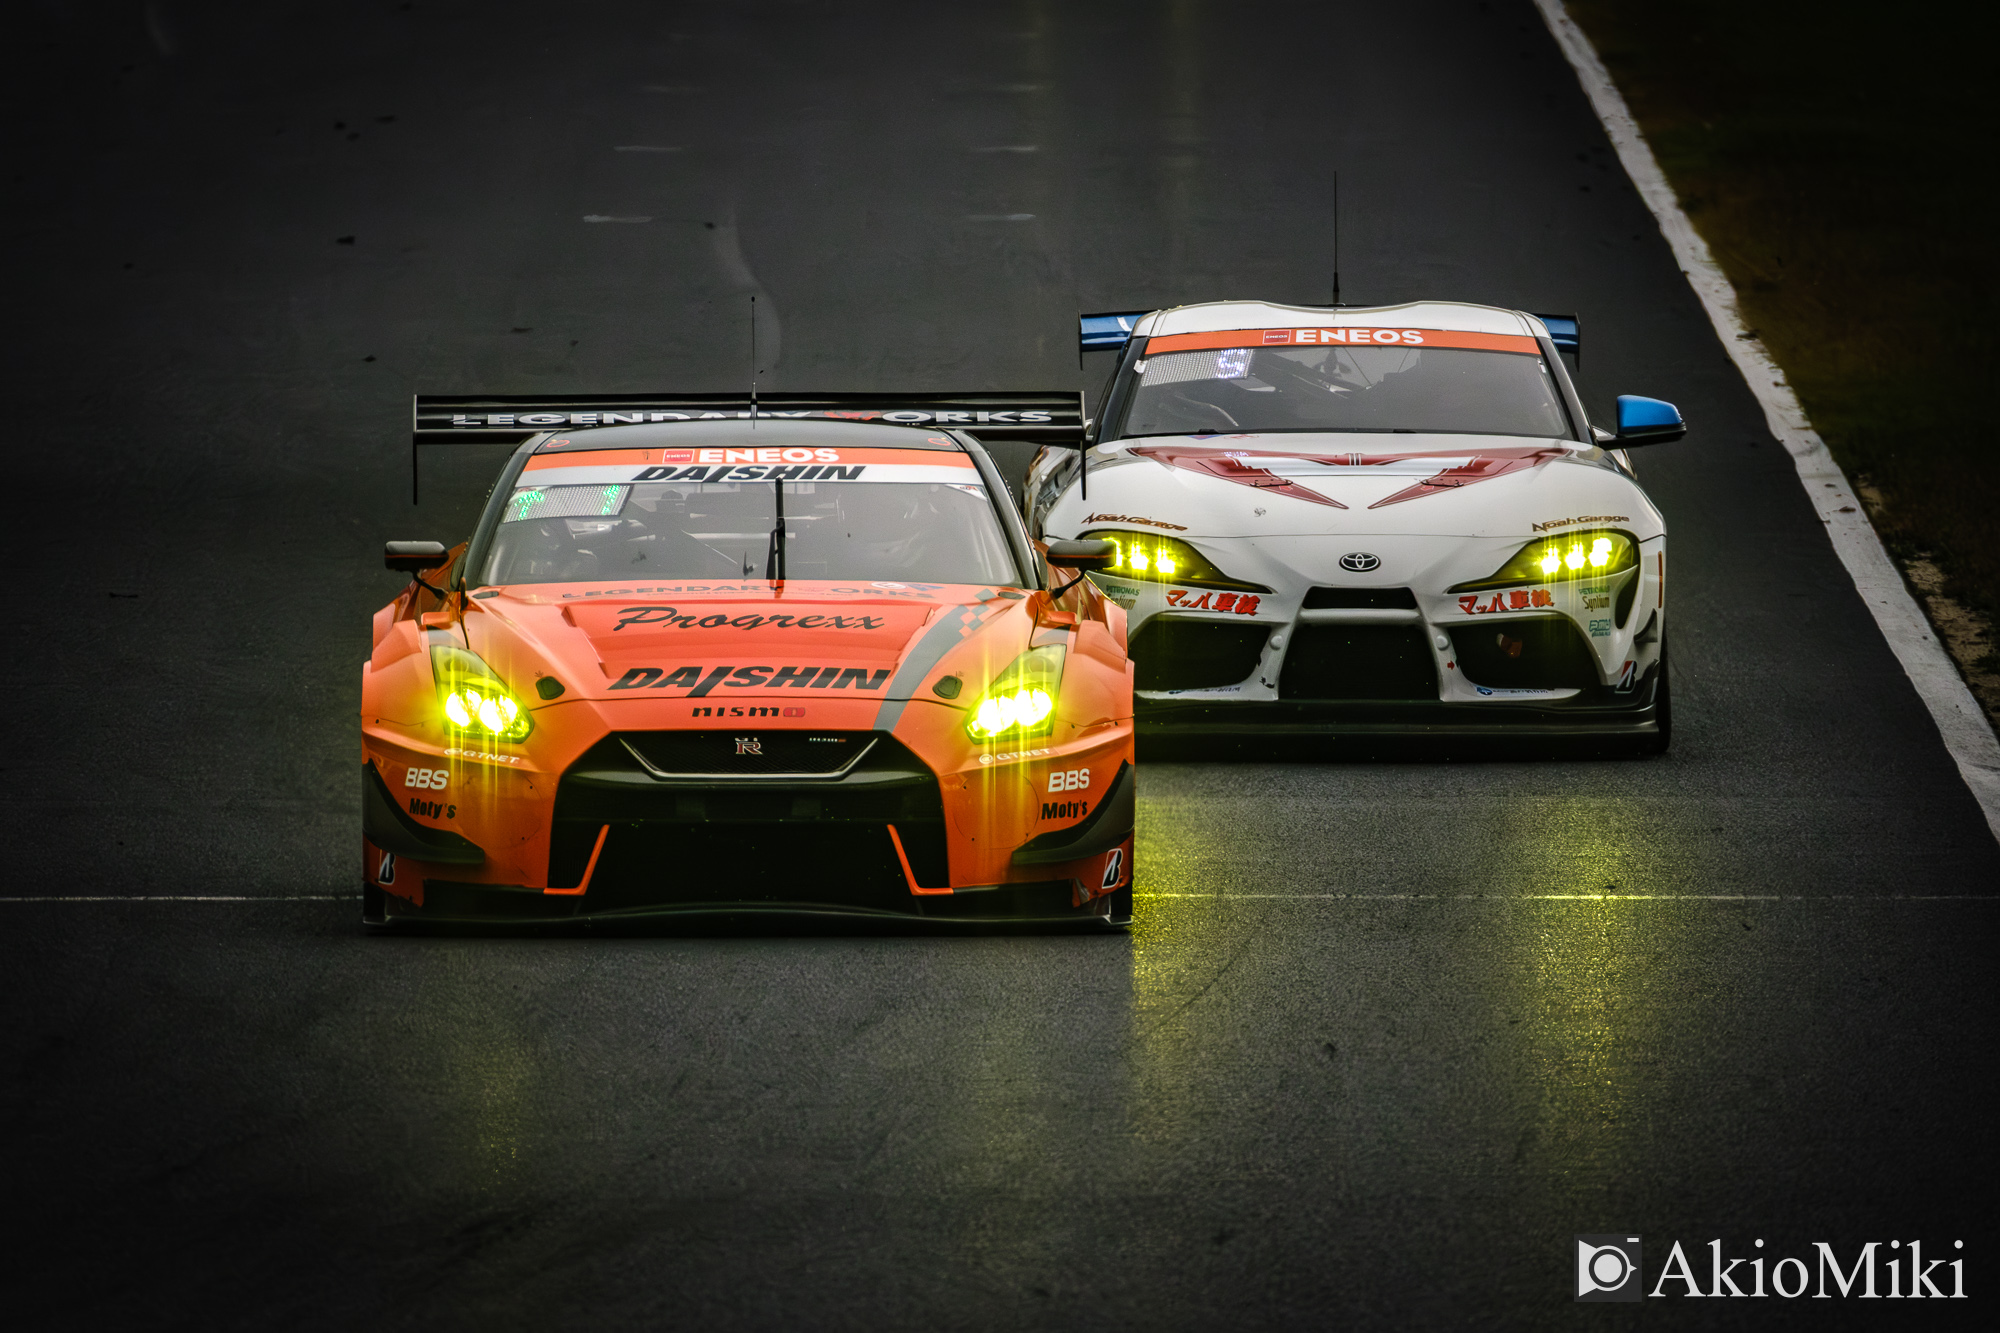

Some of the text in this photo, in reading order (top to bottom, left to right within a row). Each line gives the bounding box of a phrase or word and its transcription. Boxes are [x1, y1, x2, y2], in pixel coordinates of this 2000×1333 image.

[1295, 329, 1424, 344] ENEOS
[700, 448, 839, 463] ENEOS
[631, 465, 866, 482] DAISHIN
[562, 585, 784, 598] LEGENDAR
[1165, 589, 1262, 616] マッハ車検
[1458, 589, 1555, 615] マッハ車検
[613, 606, 885, 632] Progrexx
[606, 666, 892, 698] DAISHIN
[691, 706, 806, 718] nismo
[404, 767, 449, 790] BBS
[1047, 768, 1090, 793] BBS
[409, 798, 456, 820] Moty's
[1041, 800, 1088, 820] Moty's
